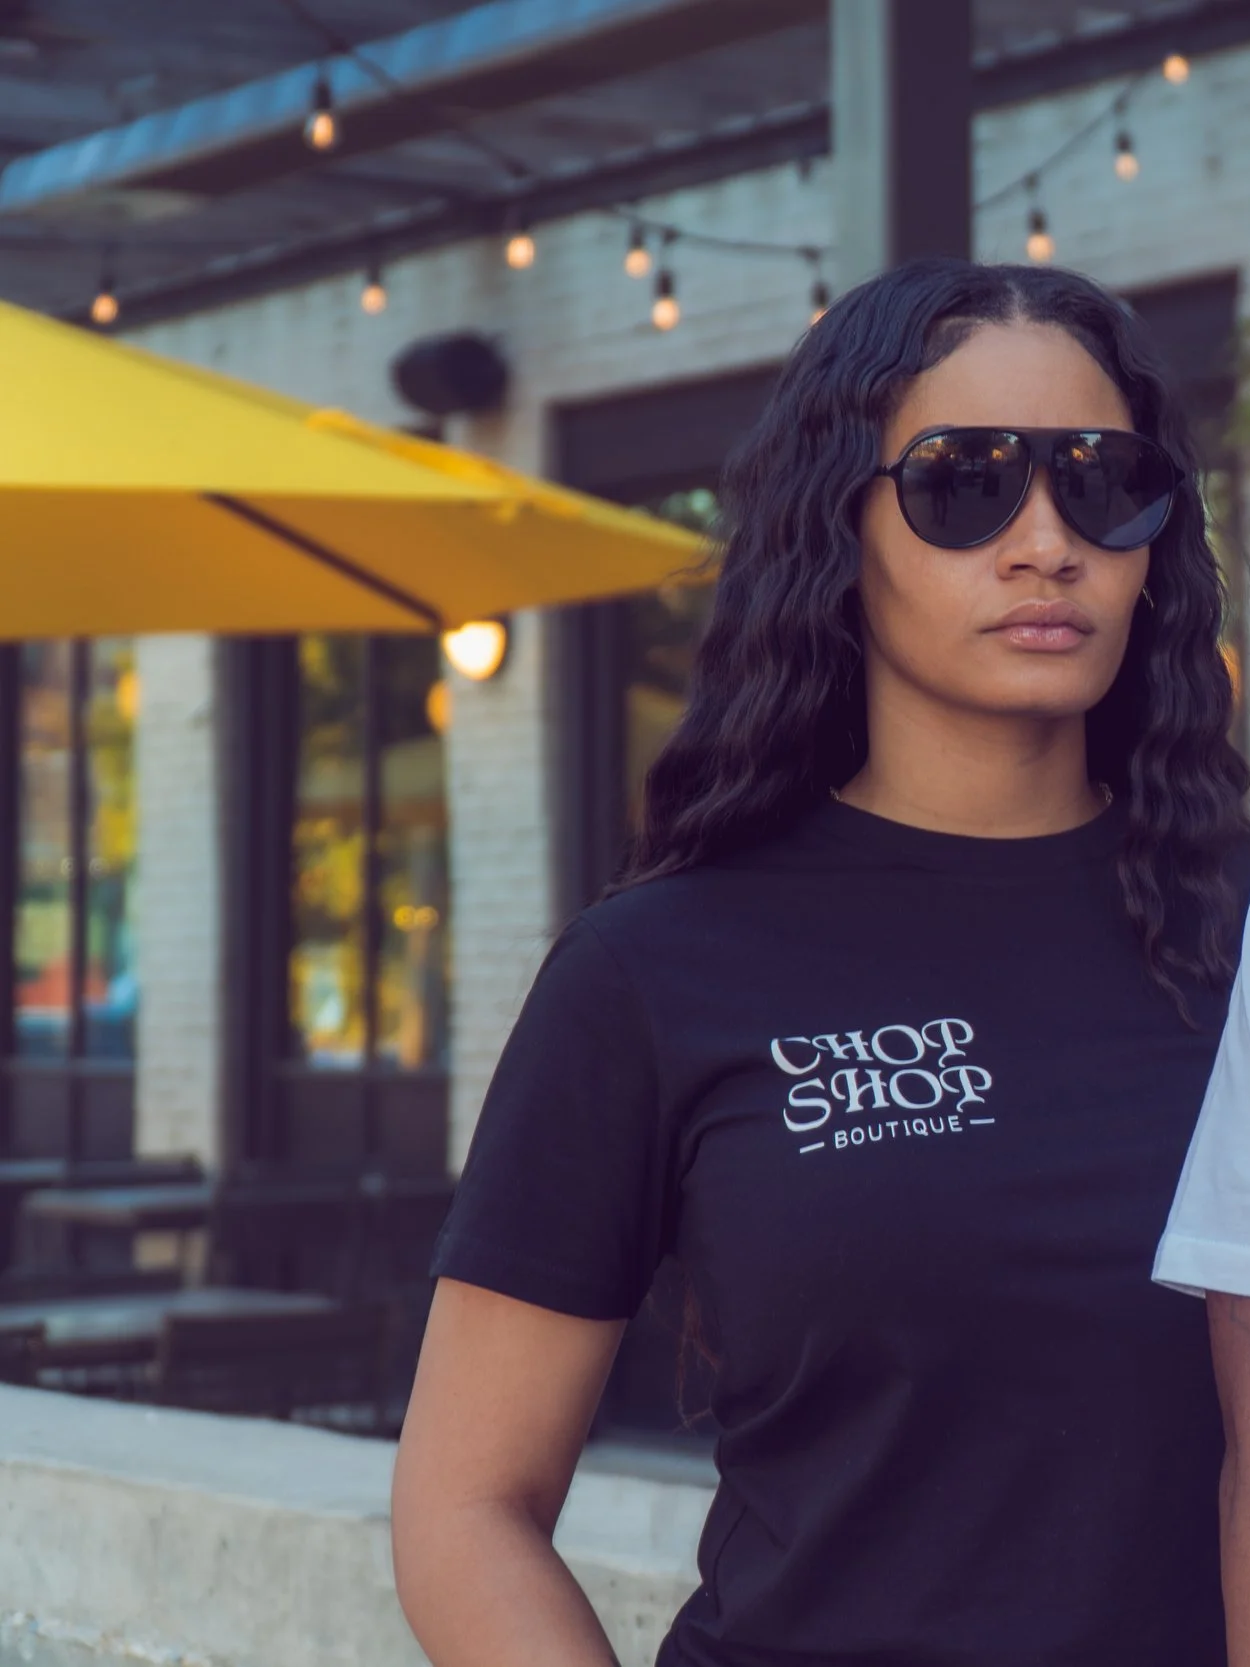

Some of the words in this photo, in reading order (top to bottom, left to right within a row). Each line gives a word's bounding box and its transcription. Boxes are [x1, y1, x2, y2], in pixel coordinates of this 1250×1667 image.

[771, 1018, 974, 1075] CHOP
[783, 1065, 992, 1132] SHOP
[834, 1115, 963, 1149] BOUTIQUE
